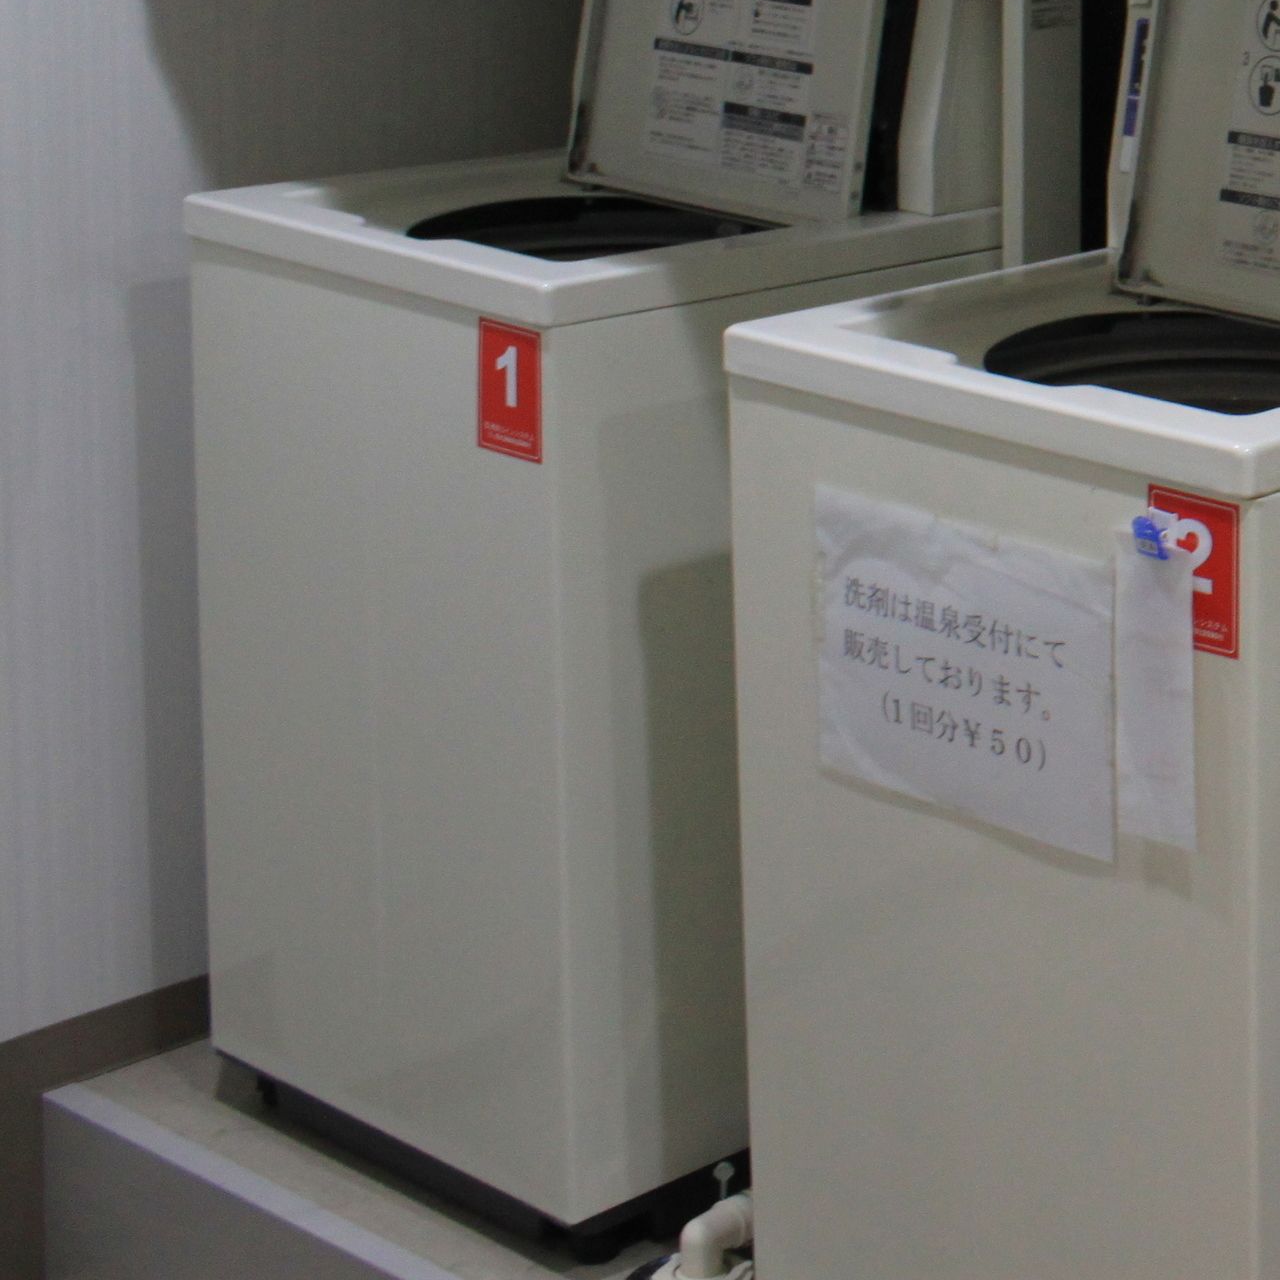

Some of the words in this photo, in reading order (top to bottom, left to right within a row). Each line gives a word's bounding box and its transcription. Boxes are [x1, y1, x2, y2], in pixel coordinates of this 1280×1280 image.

[495, 345, 519, 408] 1
[843, 575, 1067, 669] 洗剤は温泉受付にて
[843, 628, 1051, 722] 販売しております。
